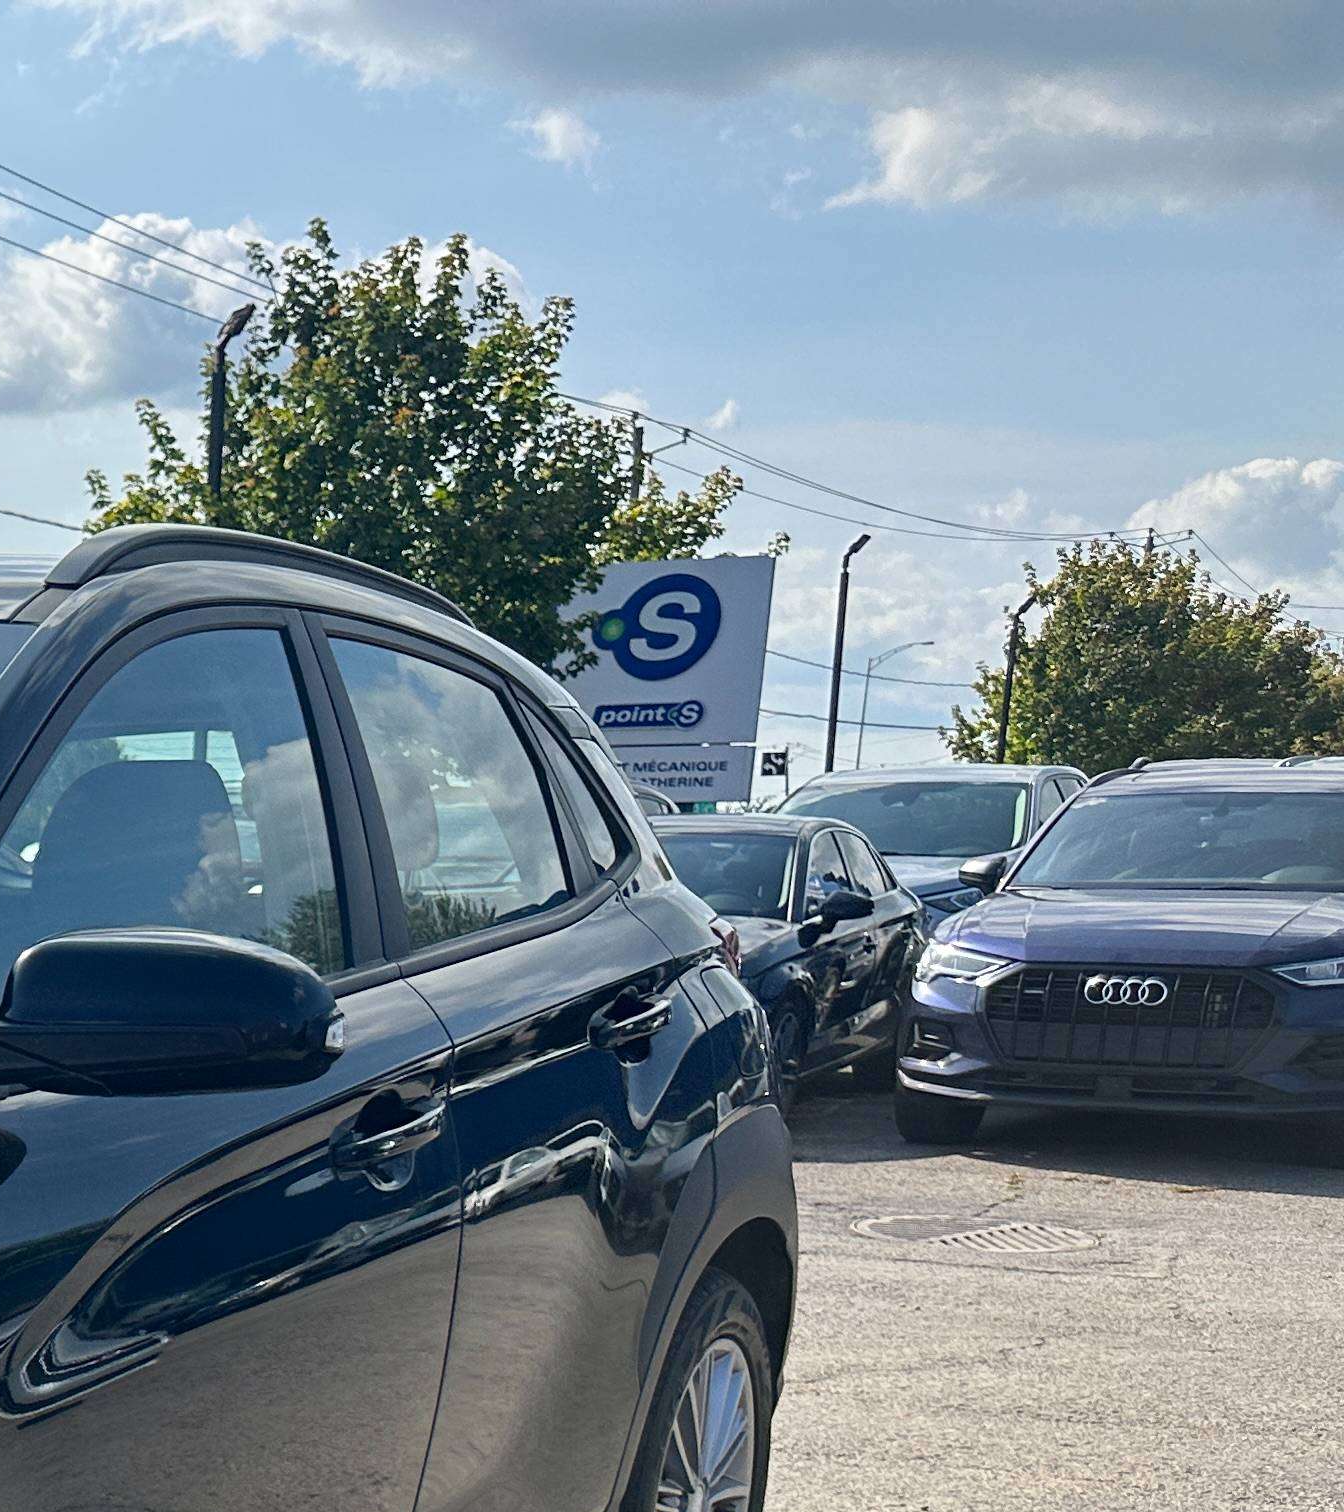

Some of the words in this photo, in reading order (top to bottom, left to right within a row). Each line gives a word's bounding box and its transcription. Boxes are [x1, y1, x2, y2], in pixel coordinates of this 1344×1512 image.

[629, 590, 701, 662] S
[599, 706, 666, 726] point
[633, 760, 728, 773] MÉCANIQUE
[640, 777, 714, 788] THERINE
